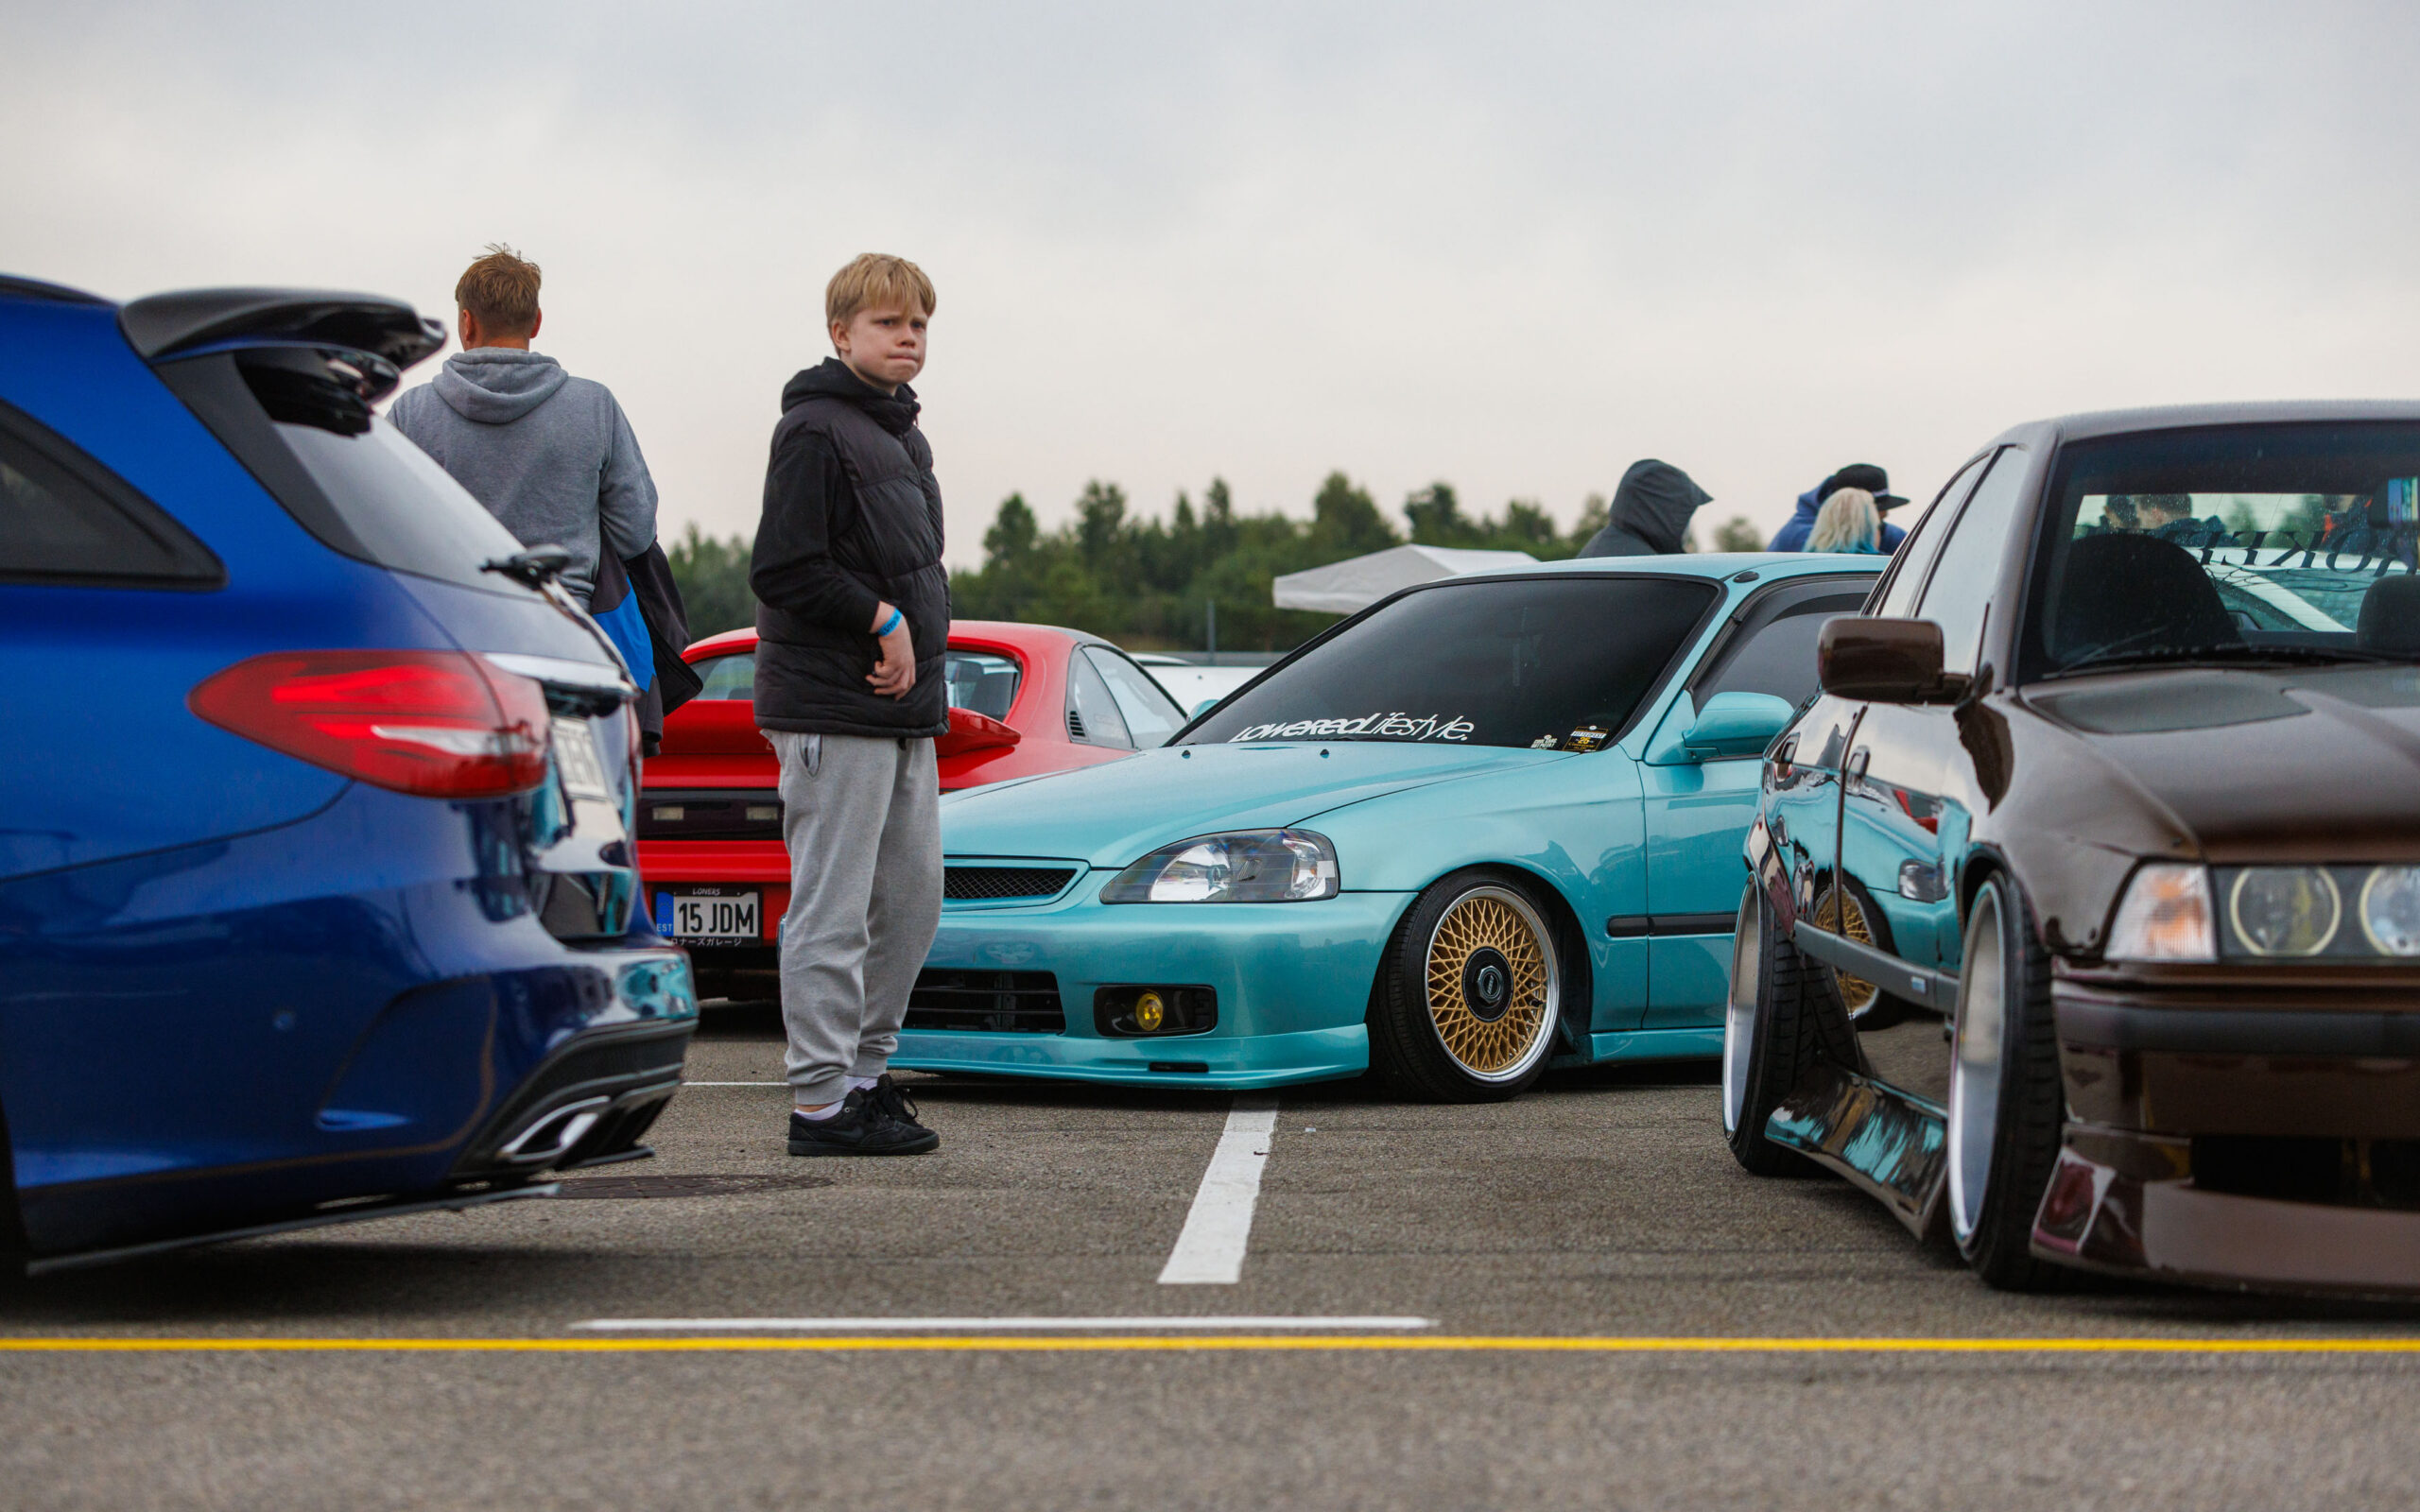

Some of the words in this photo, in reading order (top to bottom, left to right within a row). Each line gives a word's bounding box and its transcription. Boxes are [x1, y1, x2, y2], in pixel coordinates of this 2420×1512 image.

[657, 923, 672, 932] EST
[679, 903, 703, 934] 15
[708, 903, 754, 934] JDM
